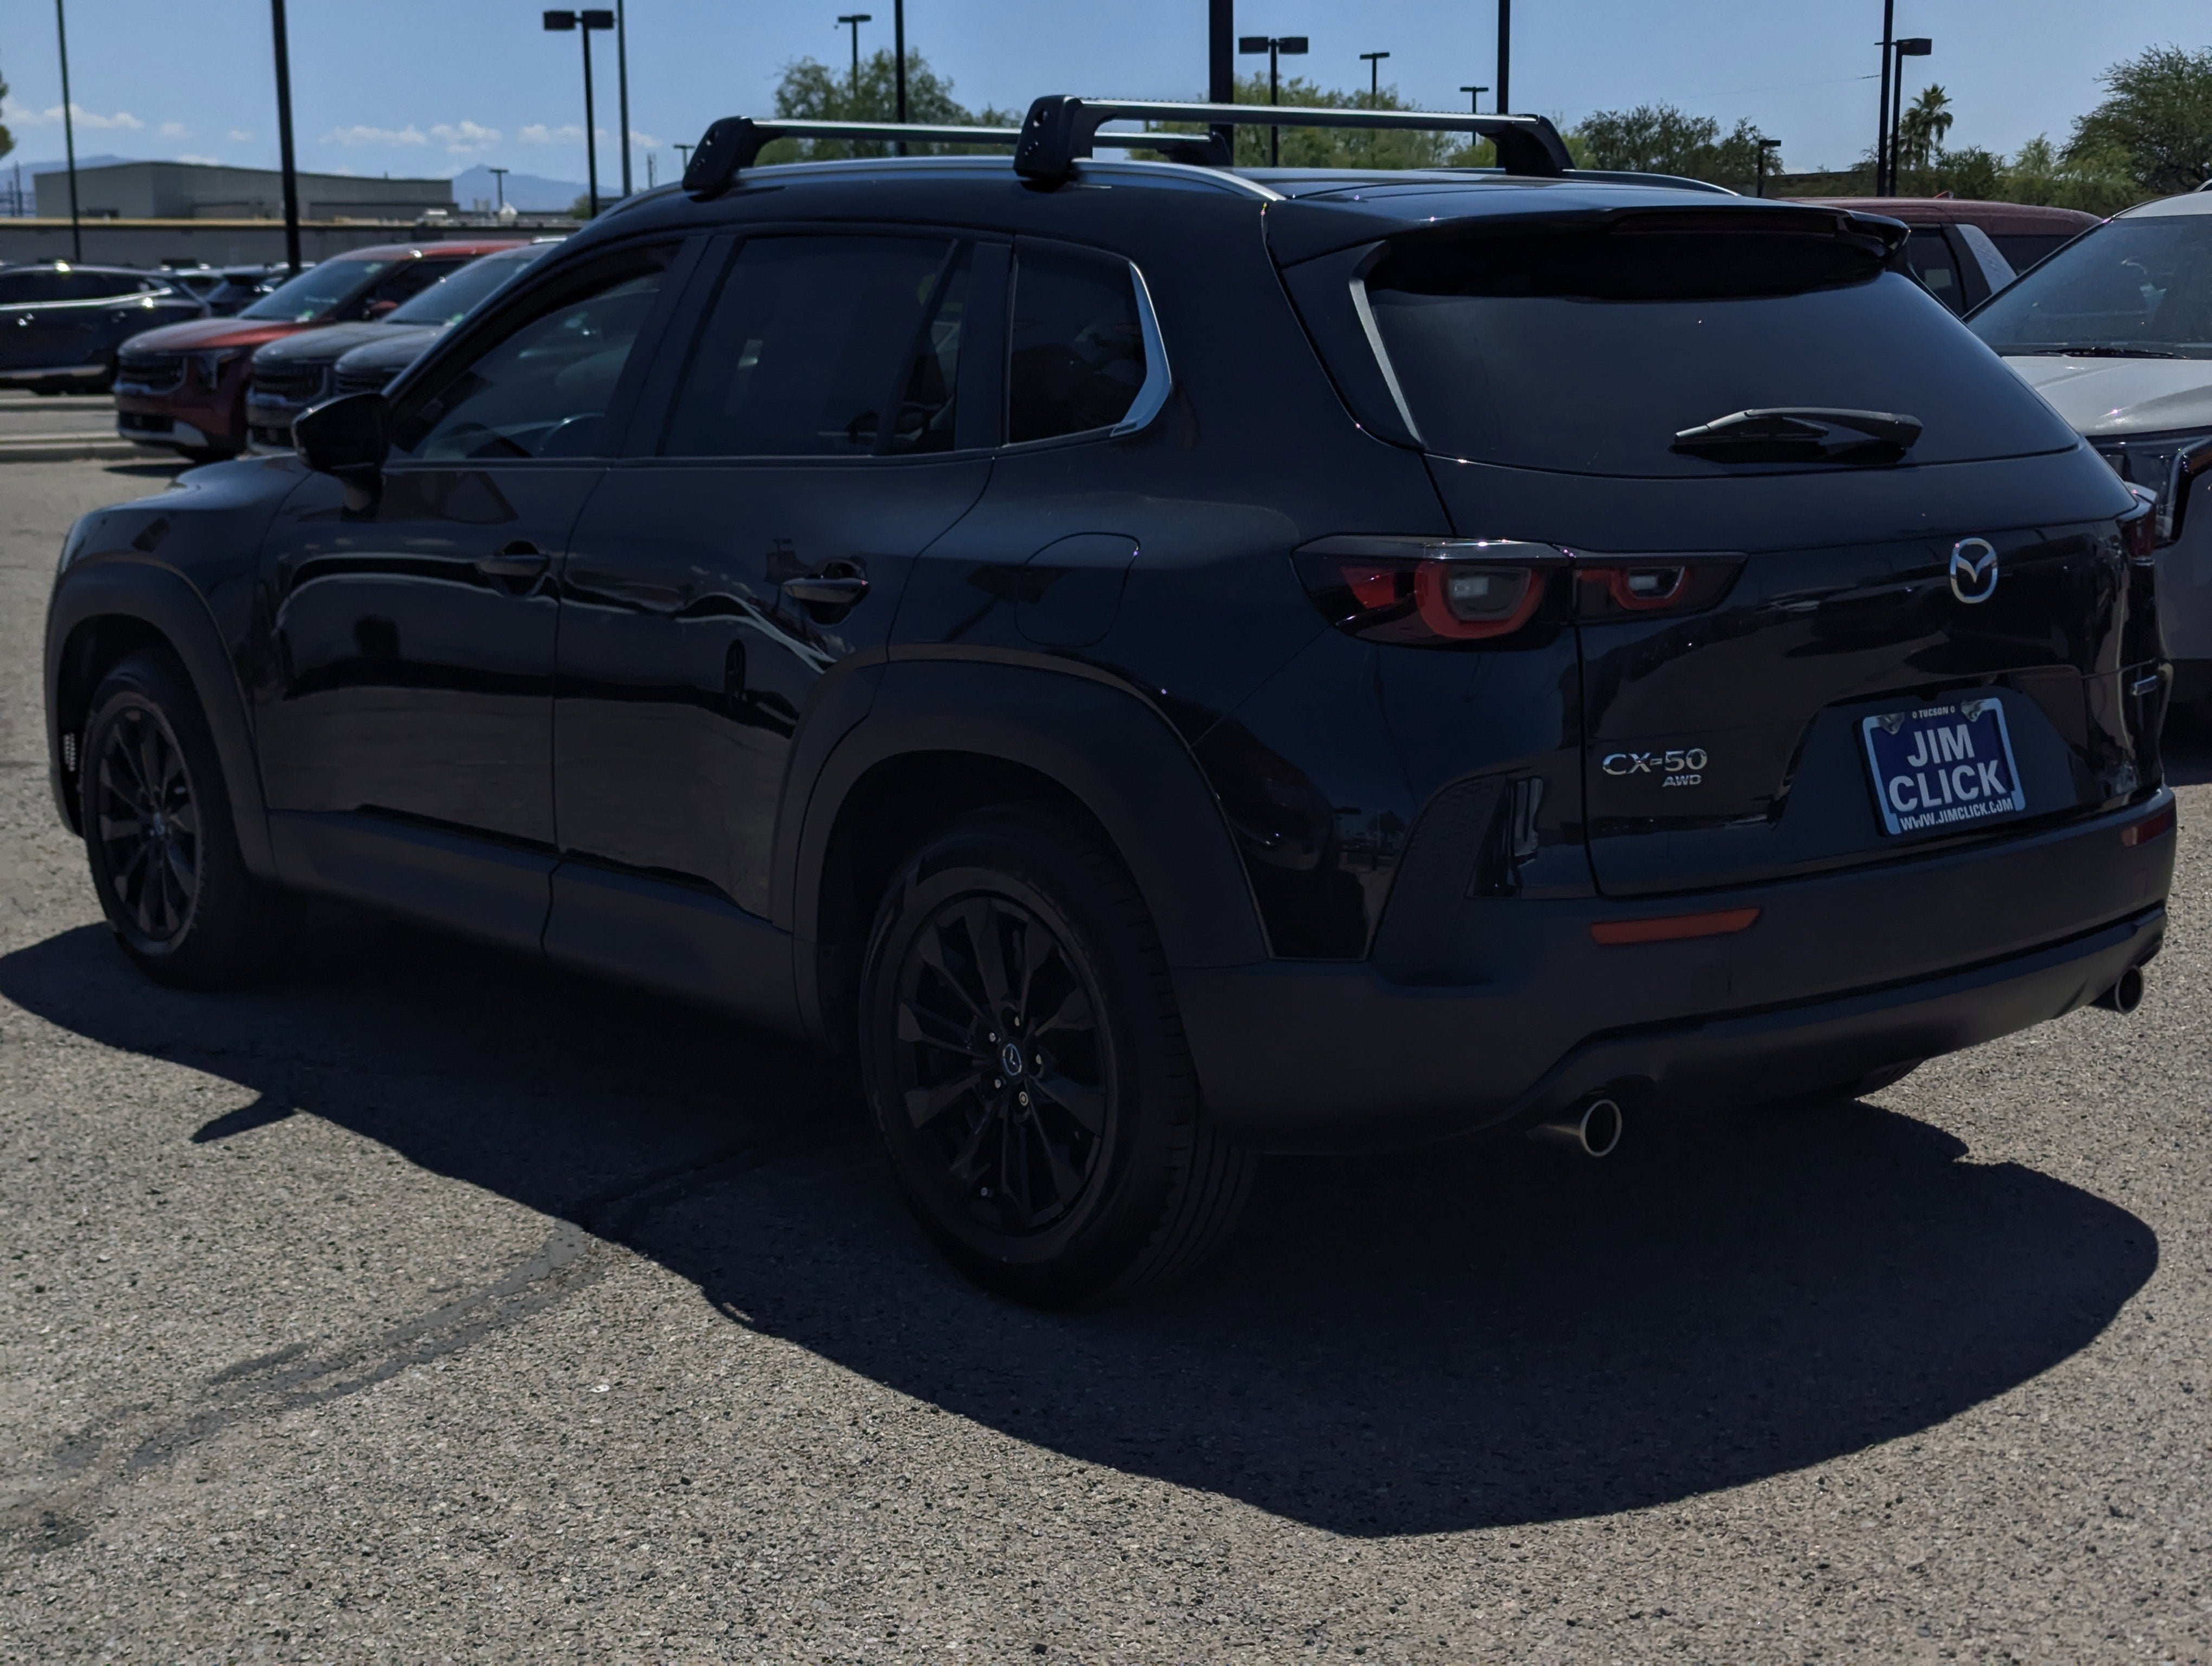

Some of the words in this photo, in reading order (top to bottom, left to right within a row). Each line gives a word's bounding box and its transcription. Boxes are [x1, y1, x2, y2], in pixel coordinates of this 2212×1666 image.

[1918, 706, 1949, 719] TUCSON
[1907, 723, 1975, 767] JIM
[1603, 748, 1707, 775] CX-50
[1661, 774, 1702, 787] AWD
[1889, 759, 2007, 812] CLICK
[1900, 797, 2014, 831] WWW.JIMCLICK.COM
